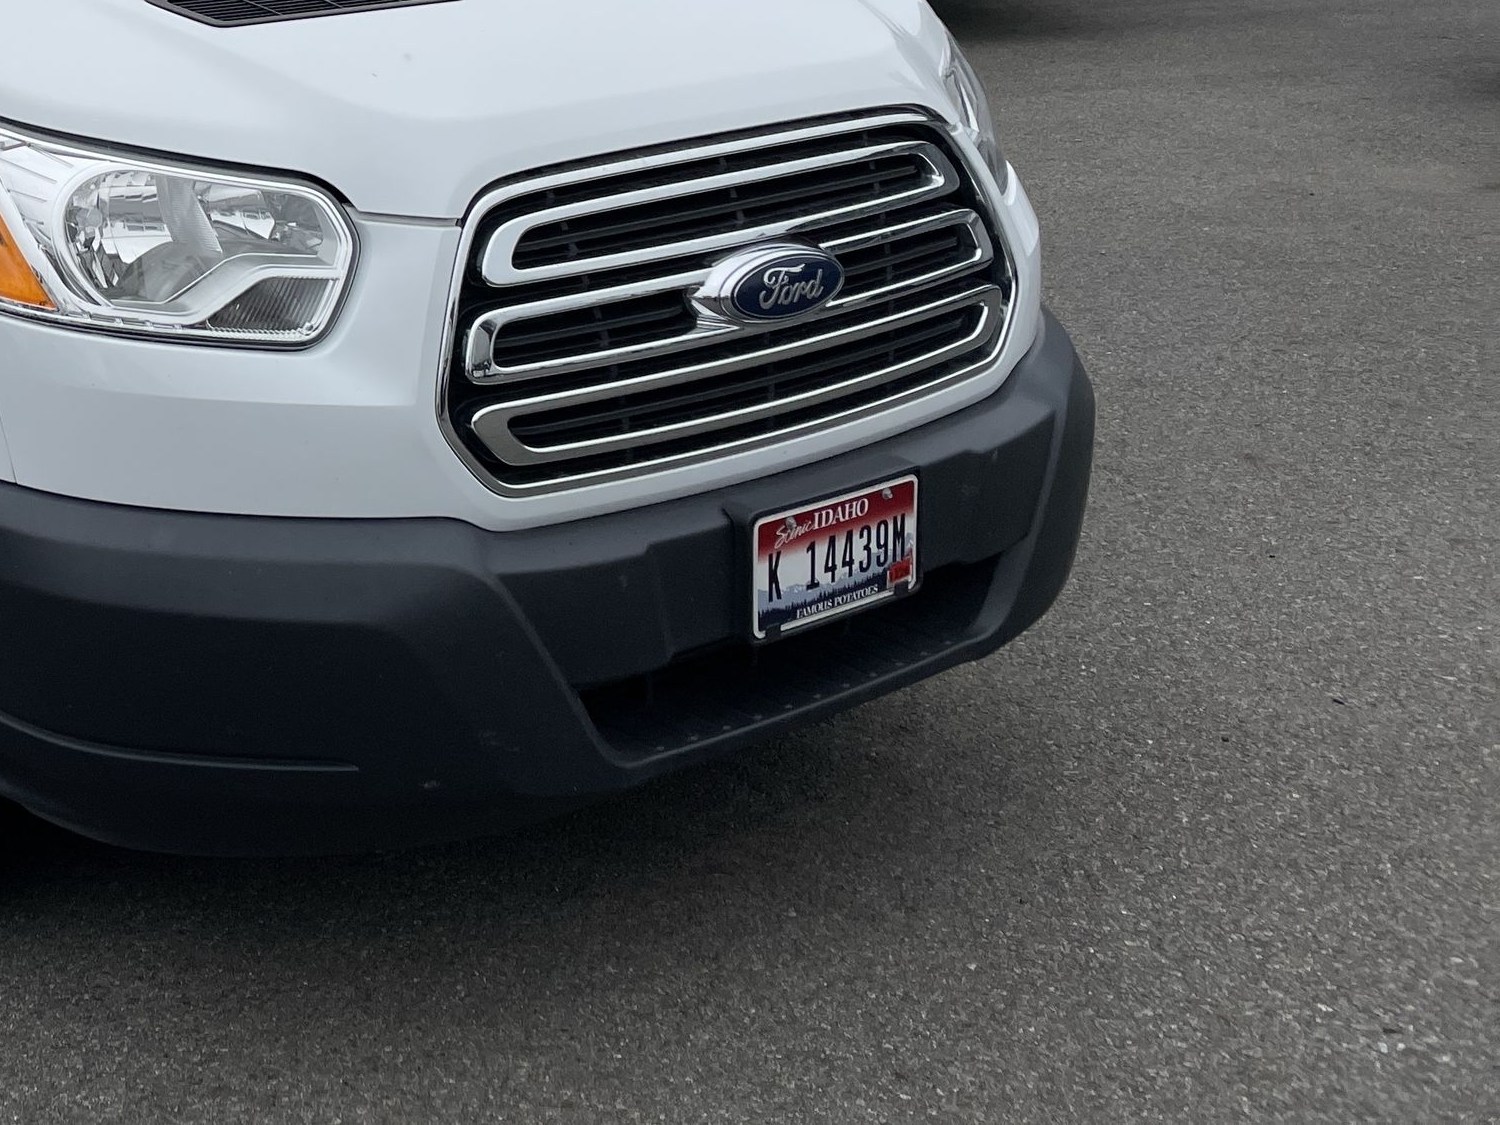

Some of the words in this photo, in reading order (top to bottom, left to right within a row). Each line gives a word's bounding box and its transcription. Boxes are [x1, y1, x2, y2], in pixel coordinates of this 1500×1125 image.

[758, 263, 824, 310] Ford
[812, 497, 869, 530] IDAHO
[767, 550, 782, 603] K
[796, 598, 833, 619] FAMOUS
[834, 583, 879, 607] POTATOES
